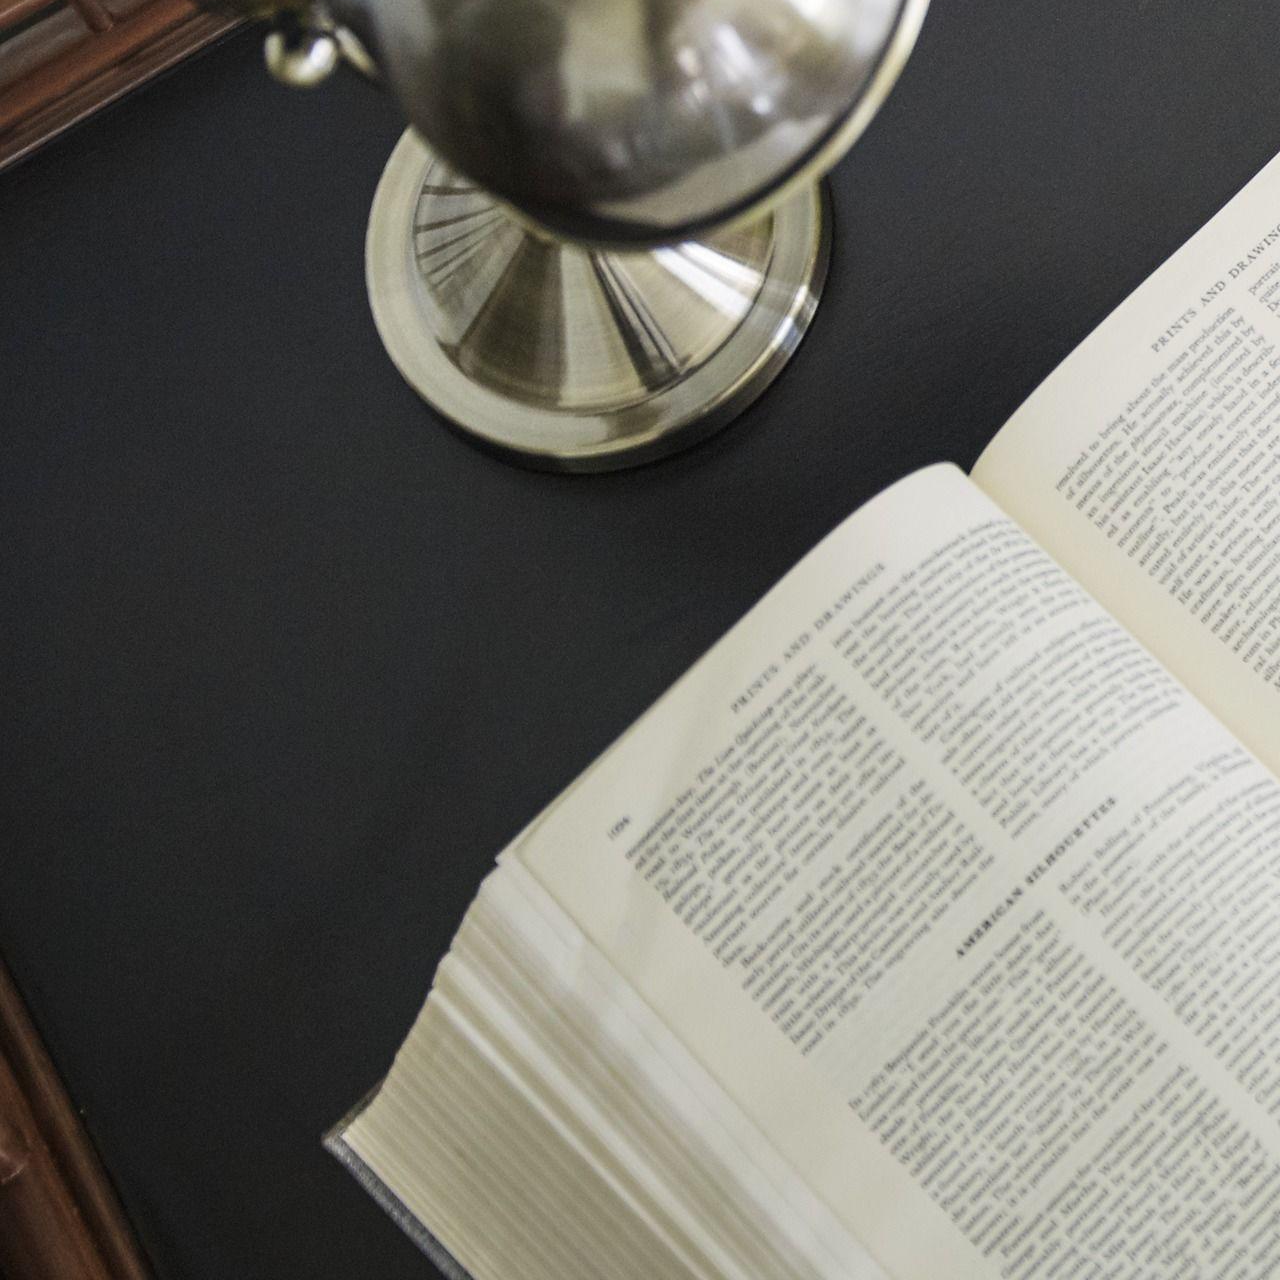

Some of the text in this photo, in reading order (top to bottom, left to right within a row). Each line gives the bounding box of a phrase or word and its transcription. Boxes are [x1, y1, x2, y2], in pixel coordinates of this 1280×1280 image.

[1151, 308, 1197, 353] PRINTS
[1200, 280, 1227, 308] AND
[956, 887, 1023, 959] AMERICAN
